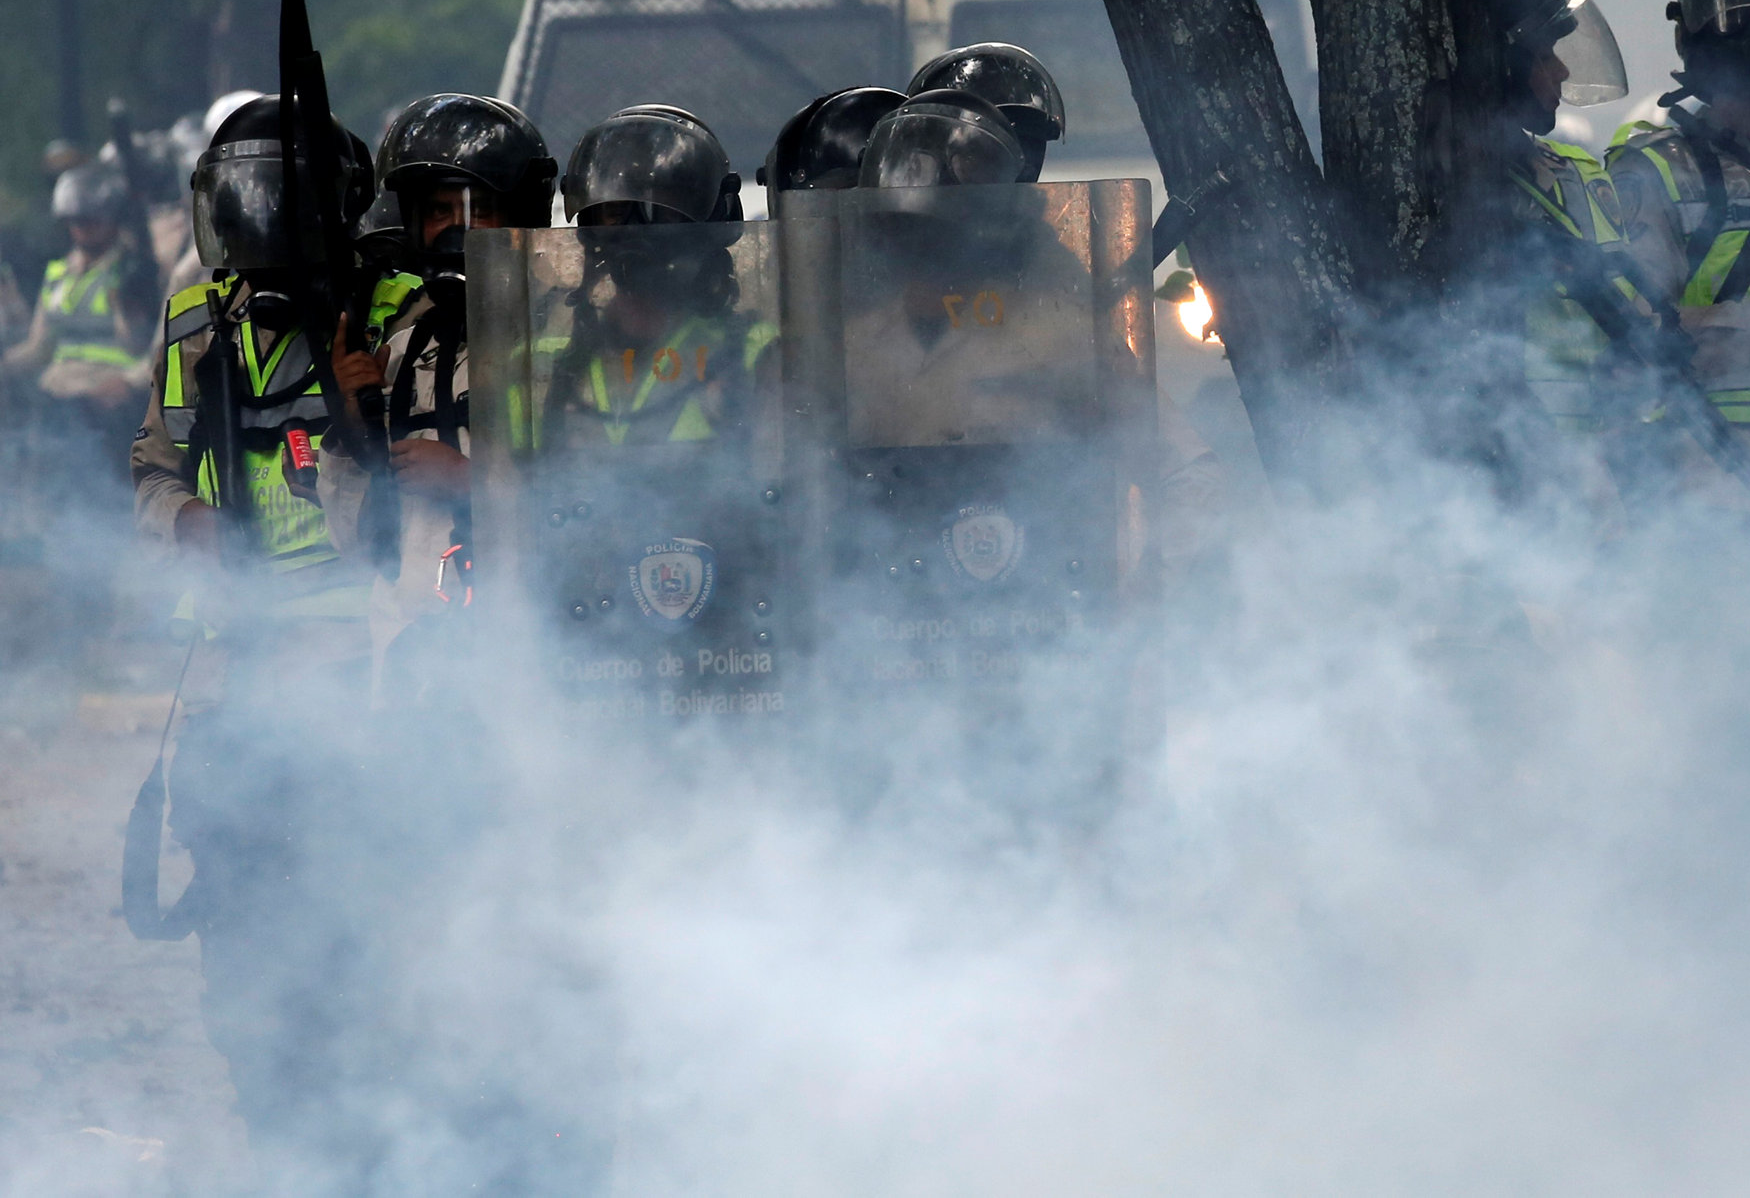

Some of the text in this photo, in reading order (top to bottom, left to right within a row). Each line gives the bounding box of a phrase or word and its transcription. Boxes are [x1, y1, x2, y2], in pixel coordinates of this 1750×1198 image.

[557, 656, 642, 684] Cuerpo
[656, 650, 685, 677] de
[659, 687, 785, 717] Bolivariana
